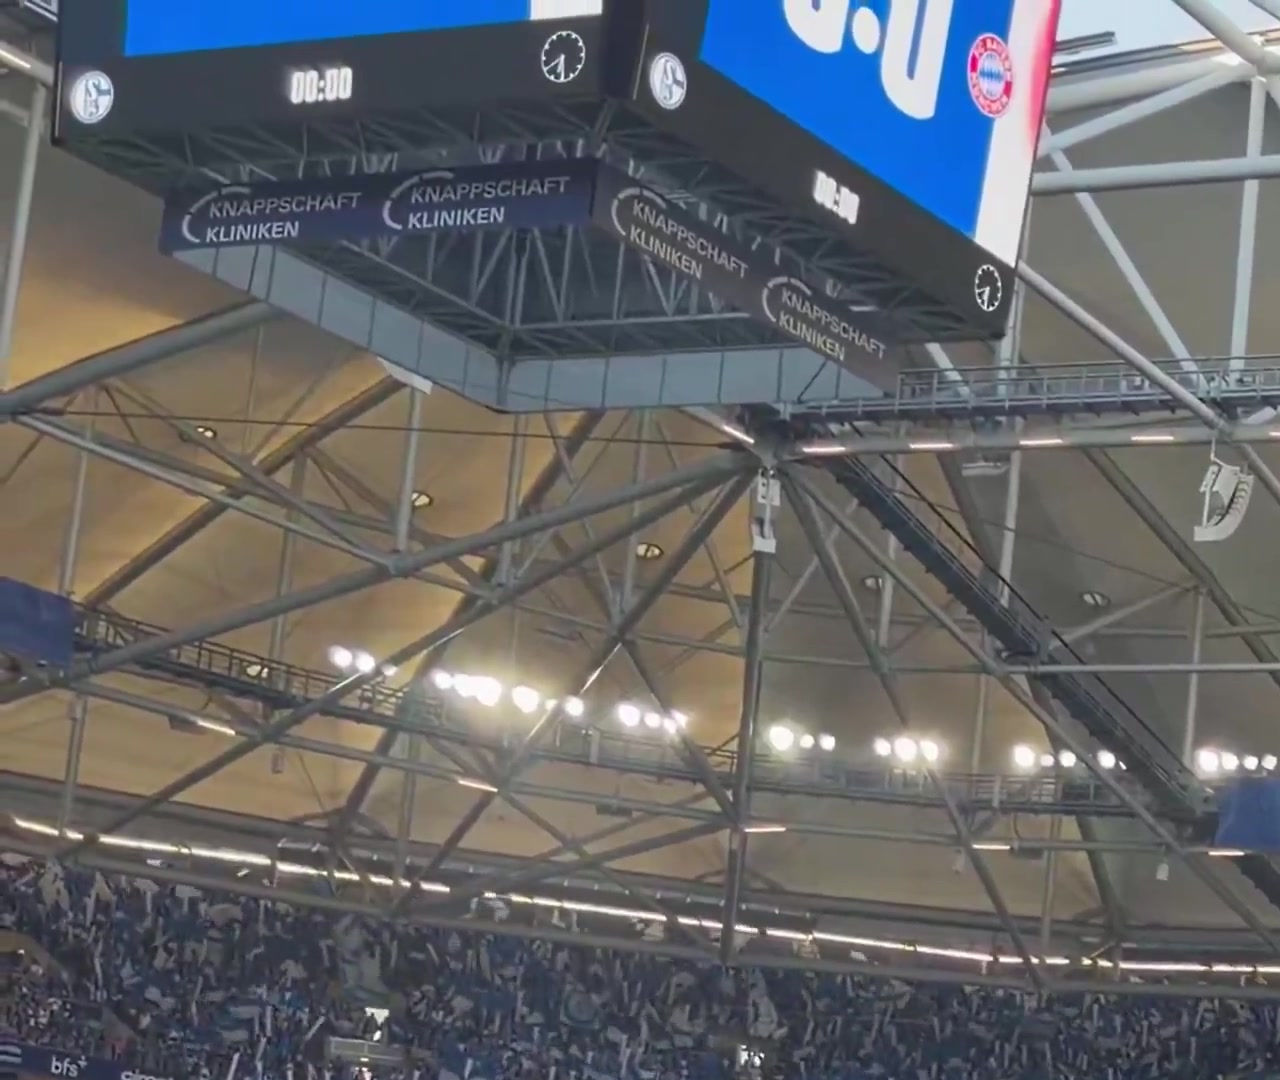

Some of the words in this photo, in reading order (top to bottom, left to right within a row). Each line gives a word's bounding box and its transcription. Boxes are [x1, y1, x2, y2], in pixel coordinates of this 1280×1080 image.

[290, 67, 352, 103] 00:00
[209, 192, 362, 219] KNAPPSCHAFT
[410, 176, 570, 203] KNAPPSCHAFT
[206, 221, 299, 244] KLINIKEN
[408, 207, 505, 230] KLINIKEN
[630, 225, 703, 279] KLINIKEN
[632, 199, 748, 279] KNAPPSCHAFT
[779, 311, 845, 361] KLINIKEN
[781, 286, 887, 360] KNAPPSCHAFT
